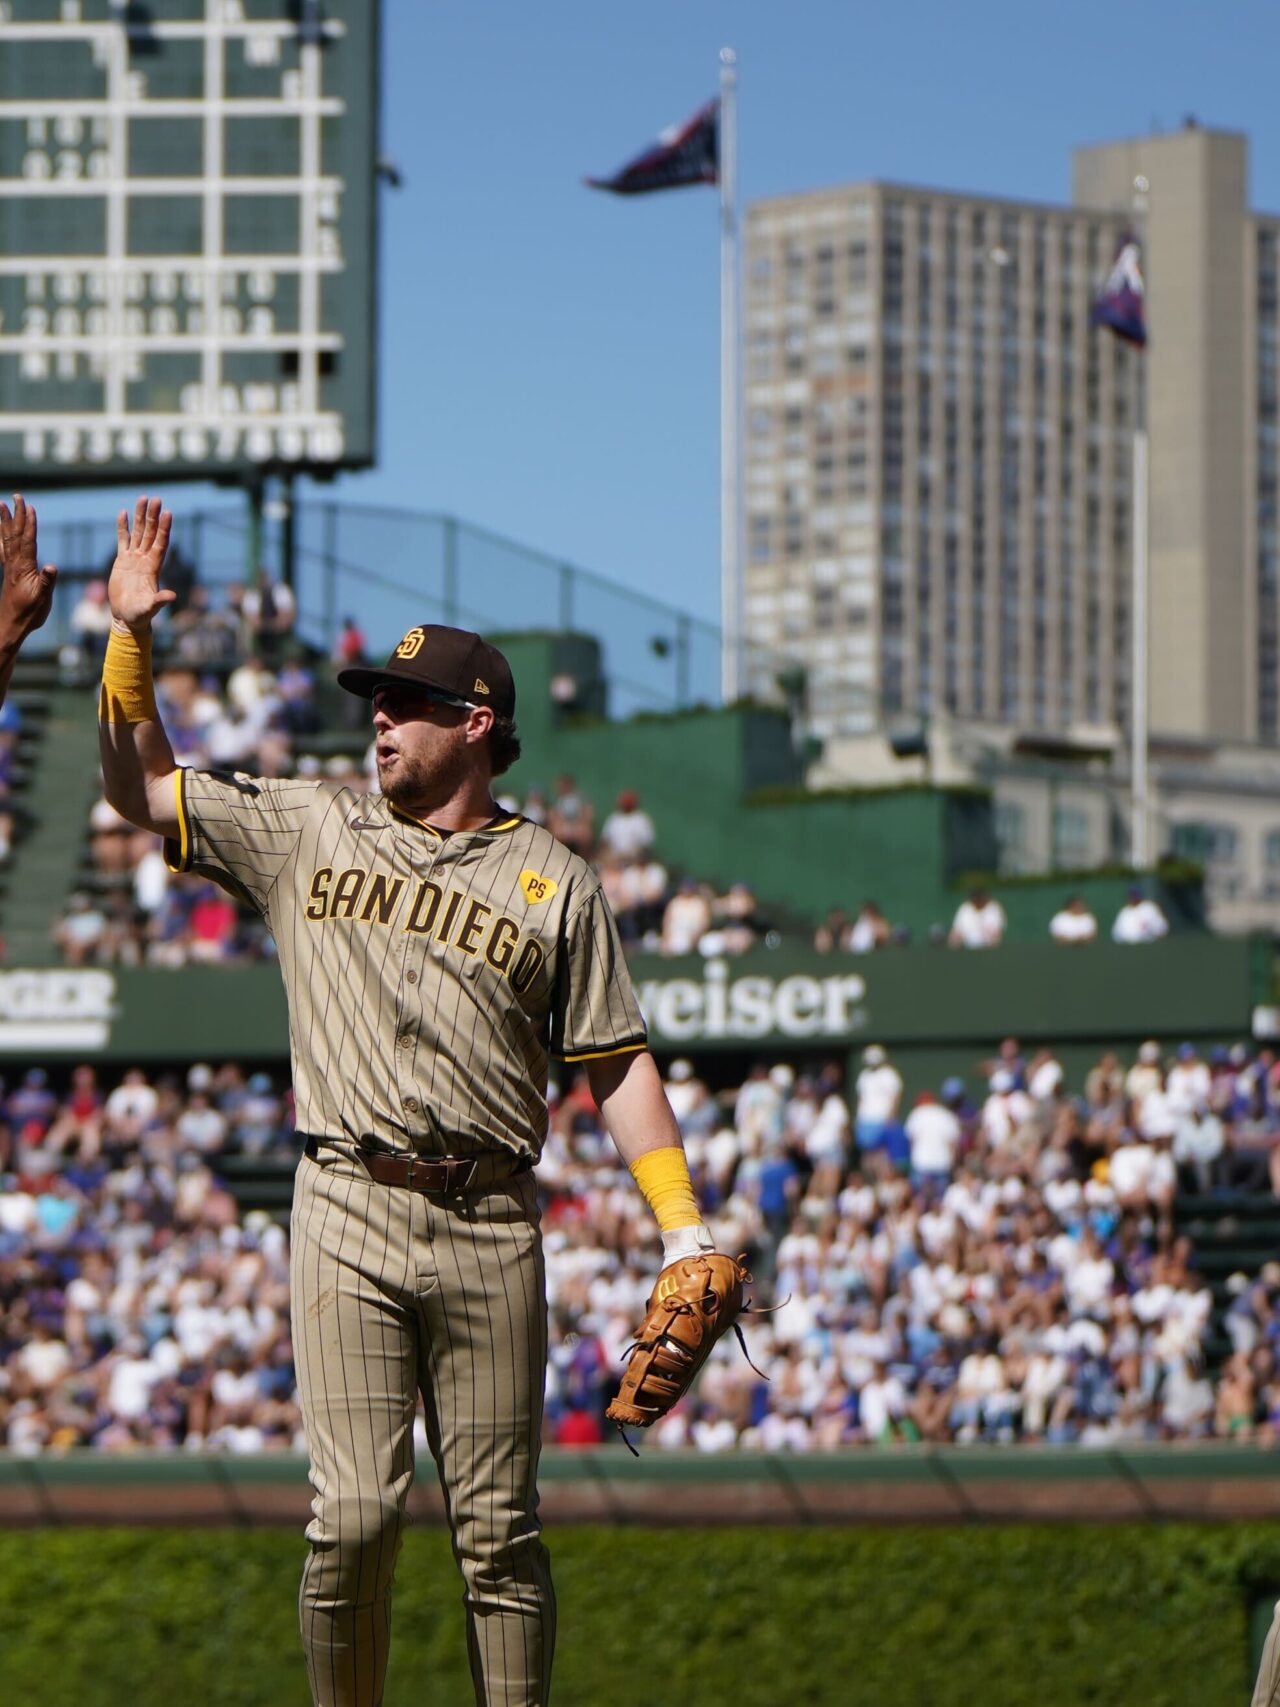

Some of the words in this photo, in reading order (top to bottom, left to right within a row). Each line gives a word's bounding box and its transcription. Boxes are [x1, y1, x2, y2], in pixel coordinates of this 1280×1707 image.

[526, 877, 547, 899] PS
[304, 866, 409, 927] SAN
[401, 879, 545, 995] DIEGO
